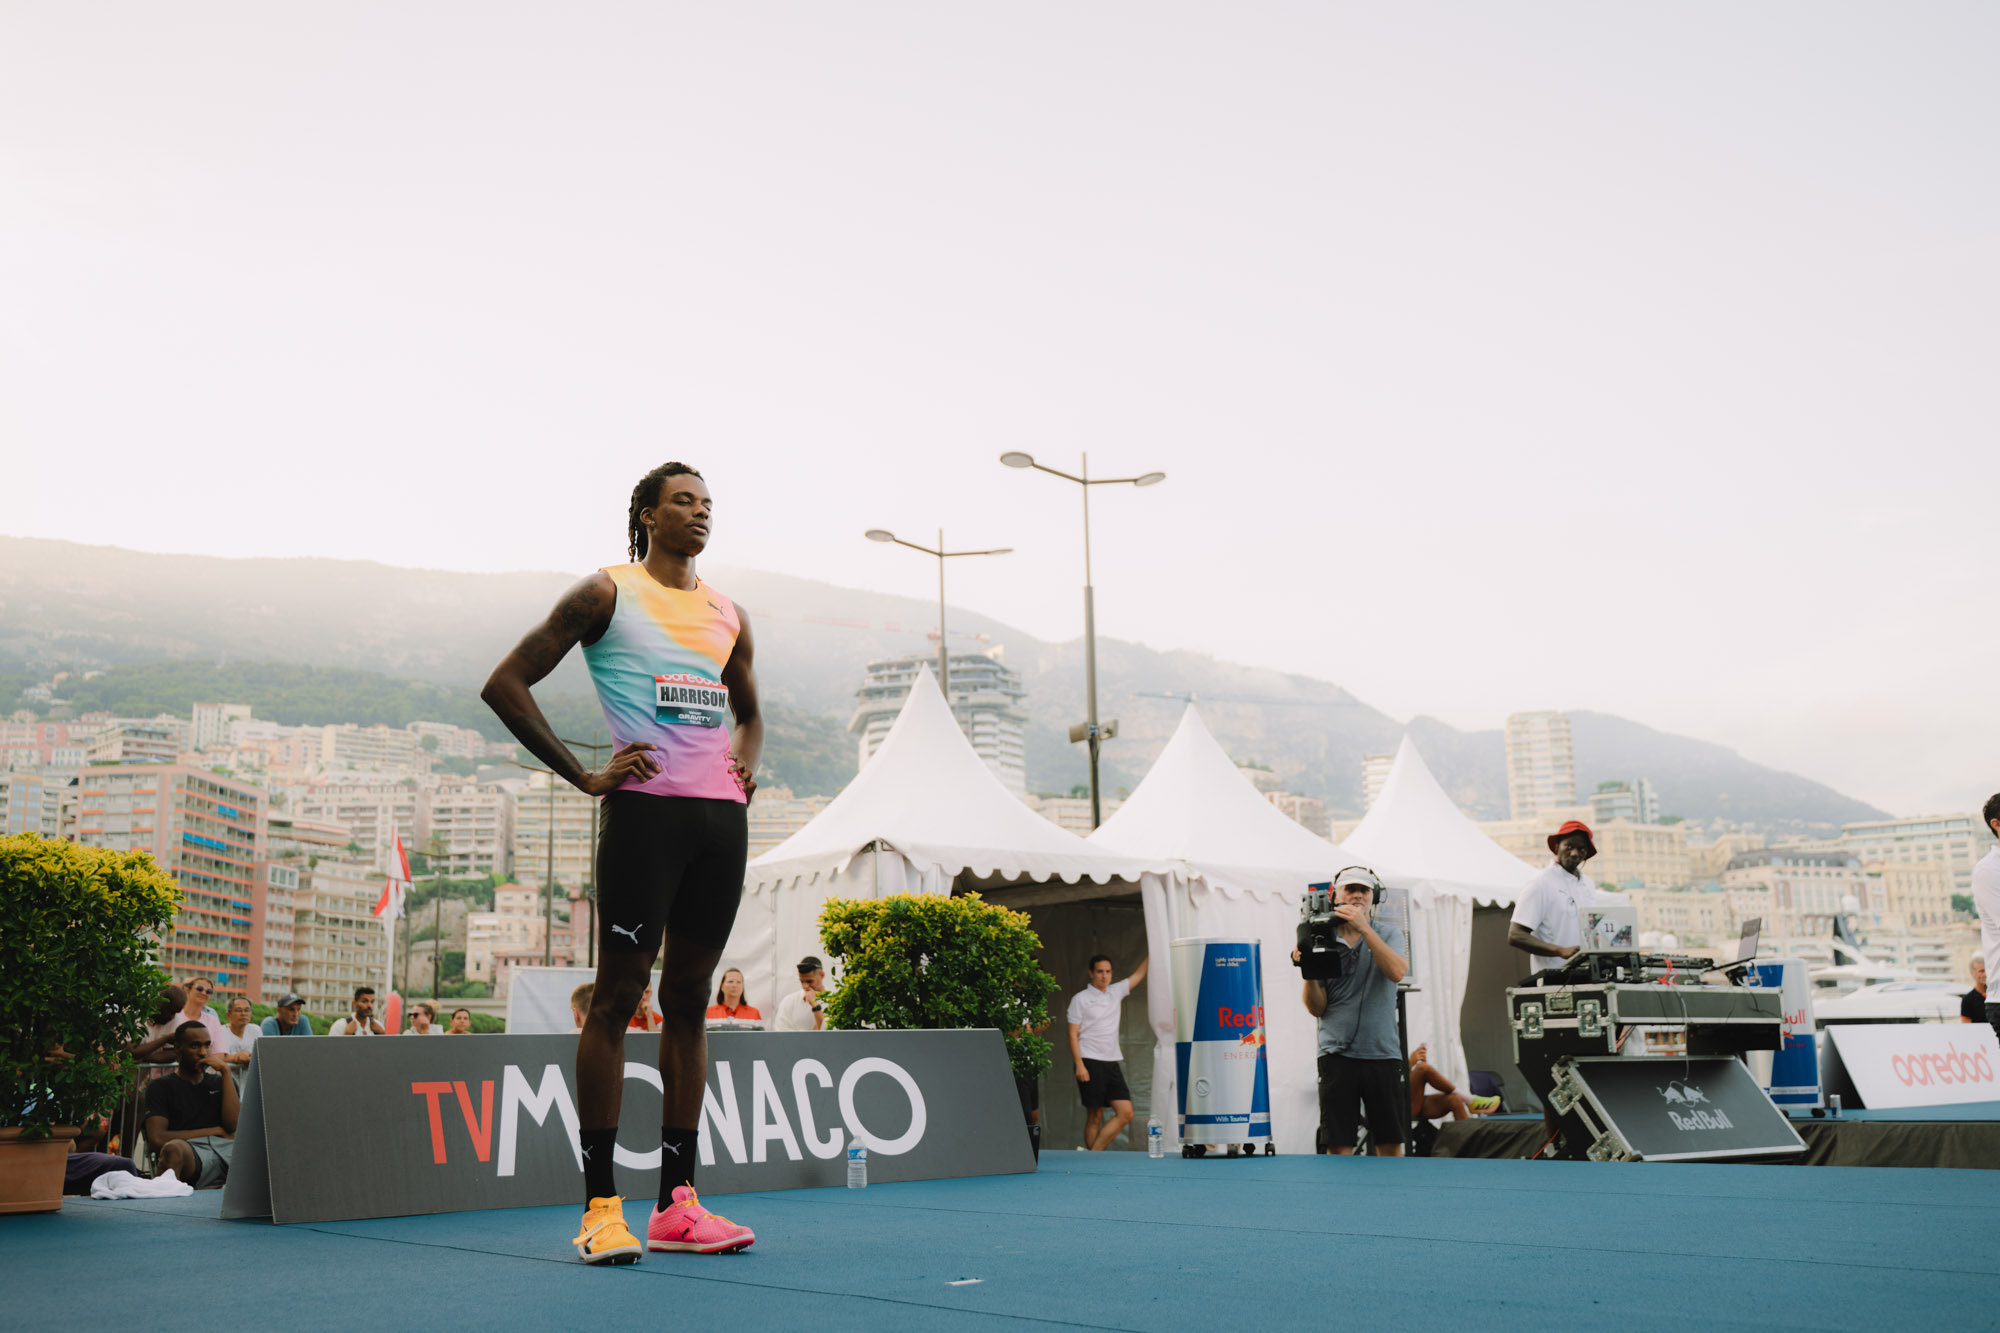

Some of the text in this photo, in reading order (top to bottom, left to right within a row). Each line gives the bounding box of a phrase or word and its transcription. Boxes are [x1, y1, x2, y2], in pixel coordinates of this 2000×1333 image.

[660, 686, 726, 708] HARRISON
[678, 713, 711, 722] GRAVITY
[1891, 1041, 1994, 1087] ooredoo
